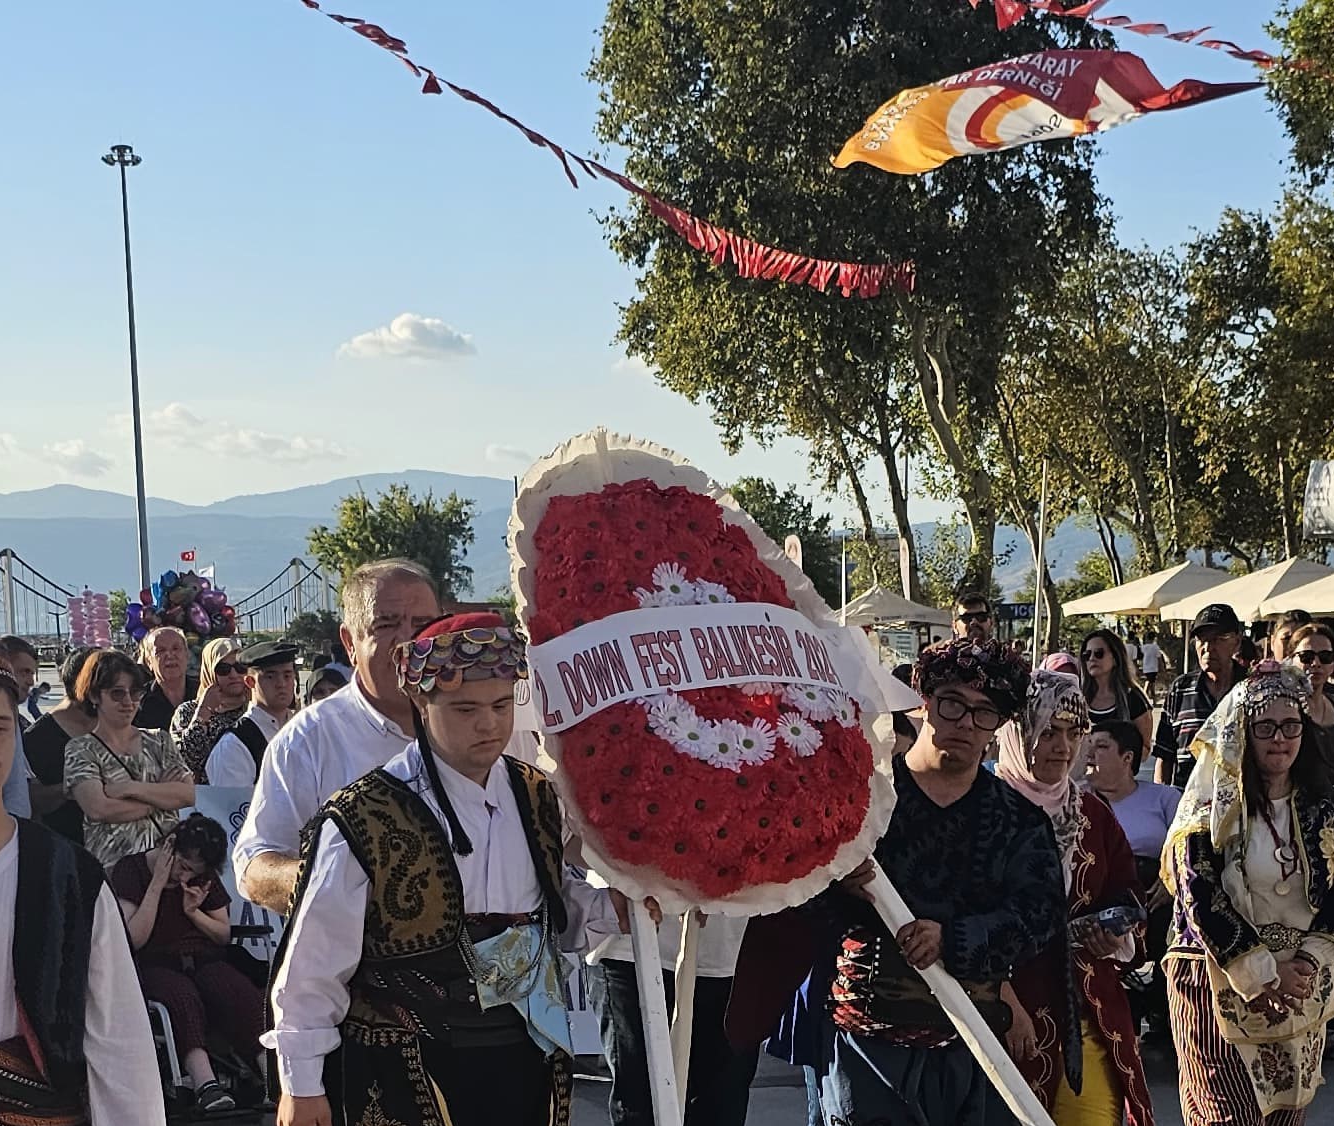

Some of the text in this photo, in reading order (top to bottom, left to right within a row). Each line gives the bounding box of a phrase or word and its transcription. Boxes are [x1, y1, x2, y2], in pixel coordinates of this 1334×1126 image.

[533, 669, 564, 728] 2.
[556, 639, 634, 717] DOWN
[630, 629, 693, 689] FEST
